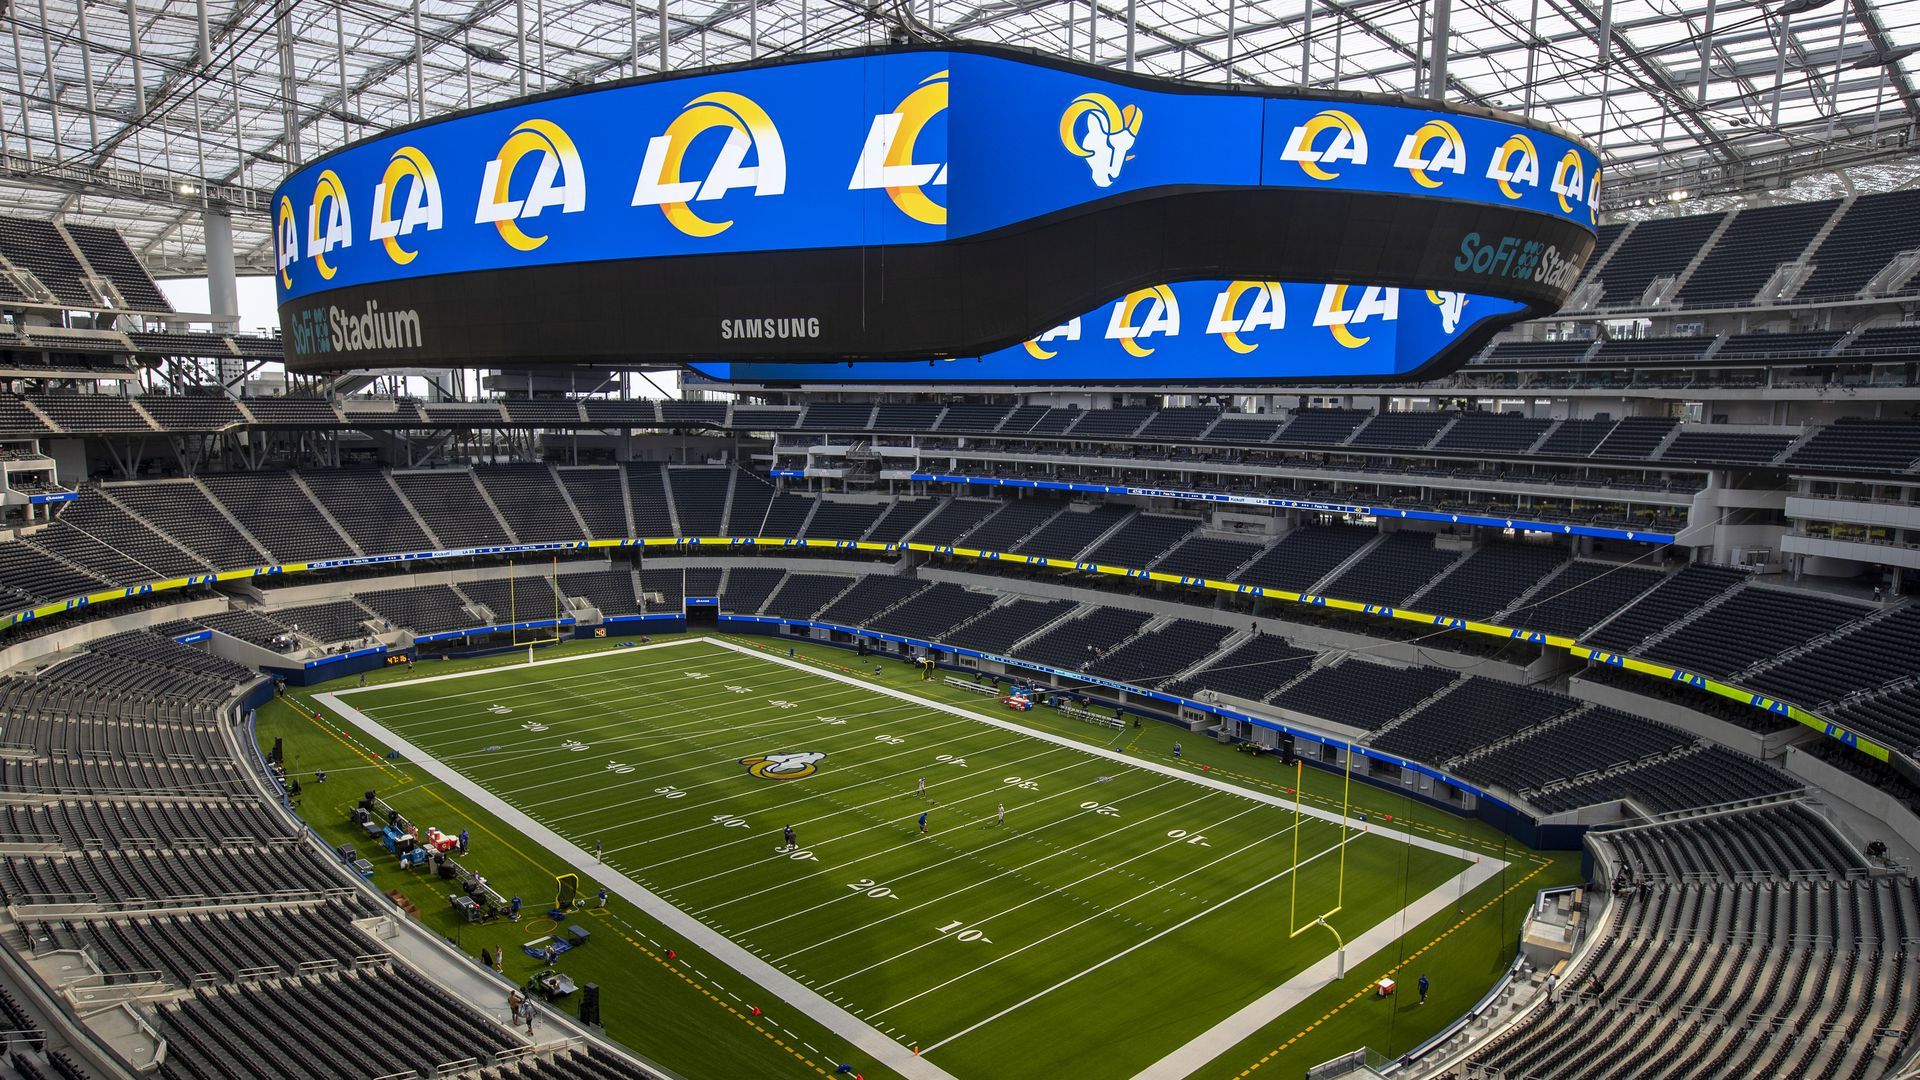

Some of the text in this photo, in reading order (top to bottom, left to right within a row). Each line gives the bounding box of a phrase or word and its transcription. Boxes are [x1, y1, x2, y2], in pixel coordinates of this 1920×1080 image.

[631, 91, 787, 206] LA
[848, 92, 948, 205] L
[1279, 110, 1368, 165] LA
[1393, 120, 1466, 174] LA
[1486, 134, 1539, 187] LA
[369, 146, 443, 241] LA
[475, 119, 587, 224] LA
[1550, 149, 1583, 202] LA
[278, 195, 298, 271] LA
[307, 169, 352, 258] LA
[1454, 232, 1521, 277] SoFi
[291, 299, 422, 354] SoFi Stadium
[721, 317, 820, 339] SAMSUNG
[1104, 284, 1181, 340] LA
[1206, 282, 1287, 335] LA
[1313, 284, 1399, 327] LA
[655, 785, 687, 799] 50
[1080, 801, 1120, 816] 20
[711, 814, 746, 828] 40
[1167, 829, 1208, 846] 10
[847, 878, 892, 899] 20
[935, 920, 984, 943] 10
